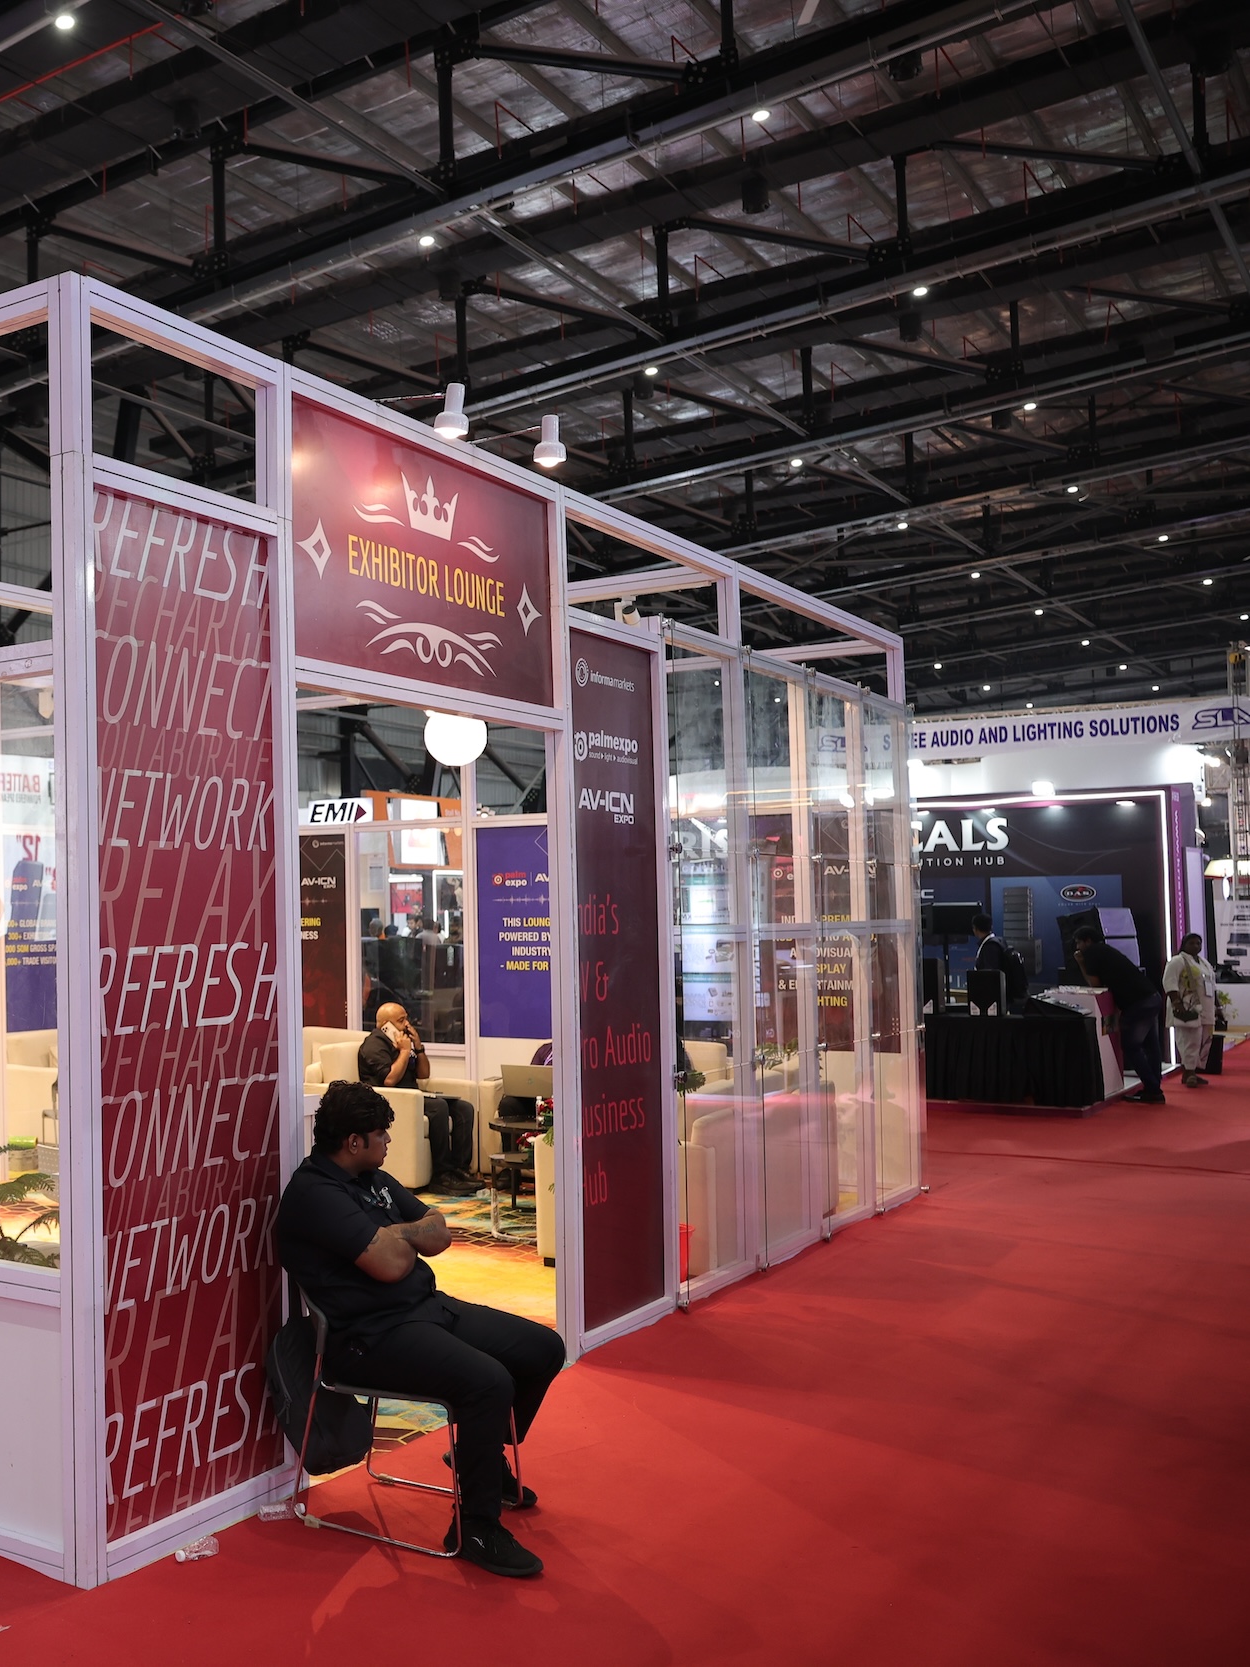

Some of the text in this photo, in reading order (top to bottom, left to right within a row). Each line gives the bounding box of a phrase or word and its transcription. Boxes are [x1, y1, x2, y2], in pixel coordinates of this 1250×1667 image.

[348, 534, 505, 617] EXHIBITOR LOUNGE
[931, 728, 974, 748] AUDIO
[978, 726, 1008, 745] AND
[1013, 719, 1084, 743] LIGHTING
[1089, 713, 1179, 738] SOLUTIONS
[588, 730, 638, 754] palmexpo
[588, 751, 601, 760] sound
[604, 752, 613, 762] light
[578, 788, 633, 814] AV-ICN
[310, 802, 354, 823] EMI
[614, 814, 634, 824] EXPO
[974, 856, 1005, 866] HUB
[505, 879, 527, 888] expo
[503, 918, 550, 927] THIS LOUNG
[499, 932, 539, 942] POWERED
[30, 944, 47, 953] GROSS
[512, 946, 551, 956] INDUSTRY
[22, 956, 39, 966] TRADE
[506, 961, 530, 971] MADE
[532, 961, 549, 971] FOR
[596, 961, 609, 1002] &
[778, 980, 787, 990] &
[604, 1023, 651, 1068] Audio
